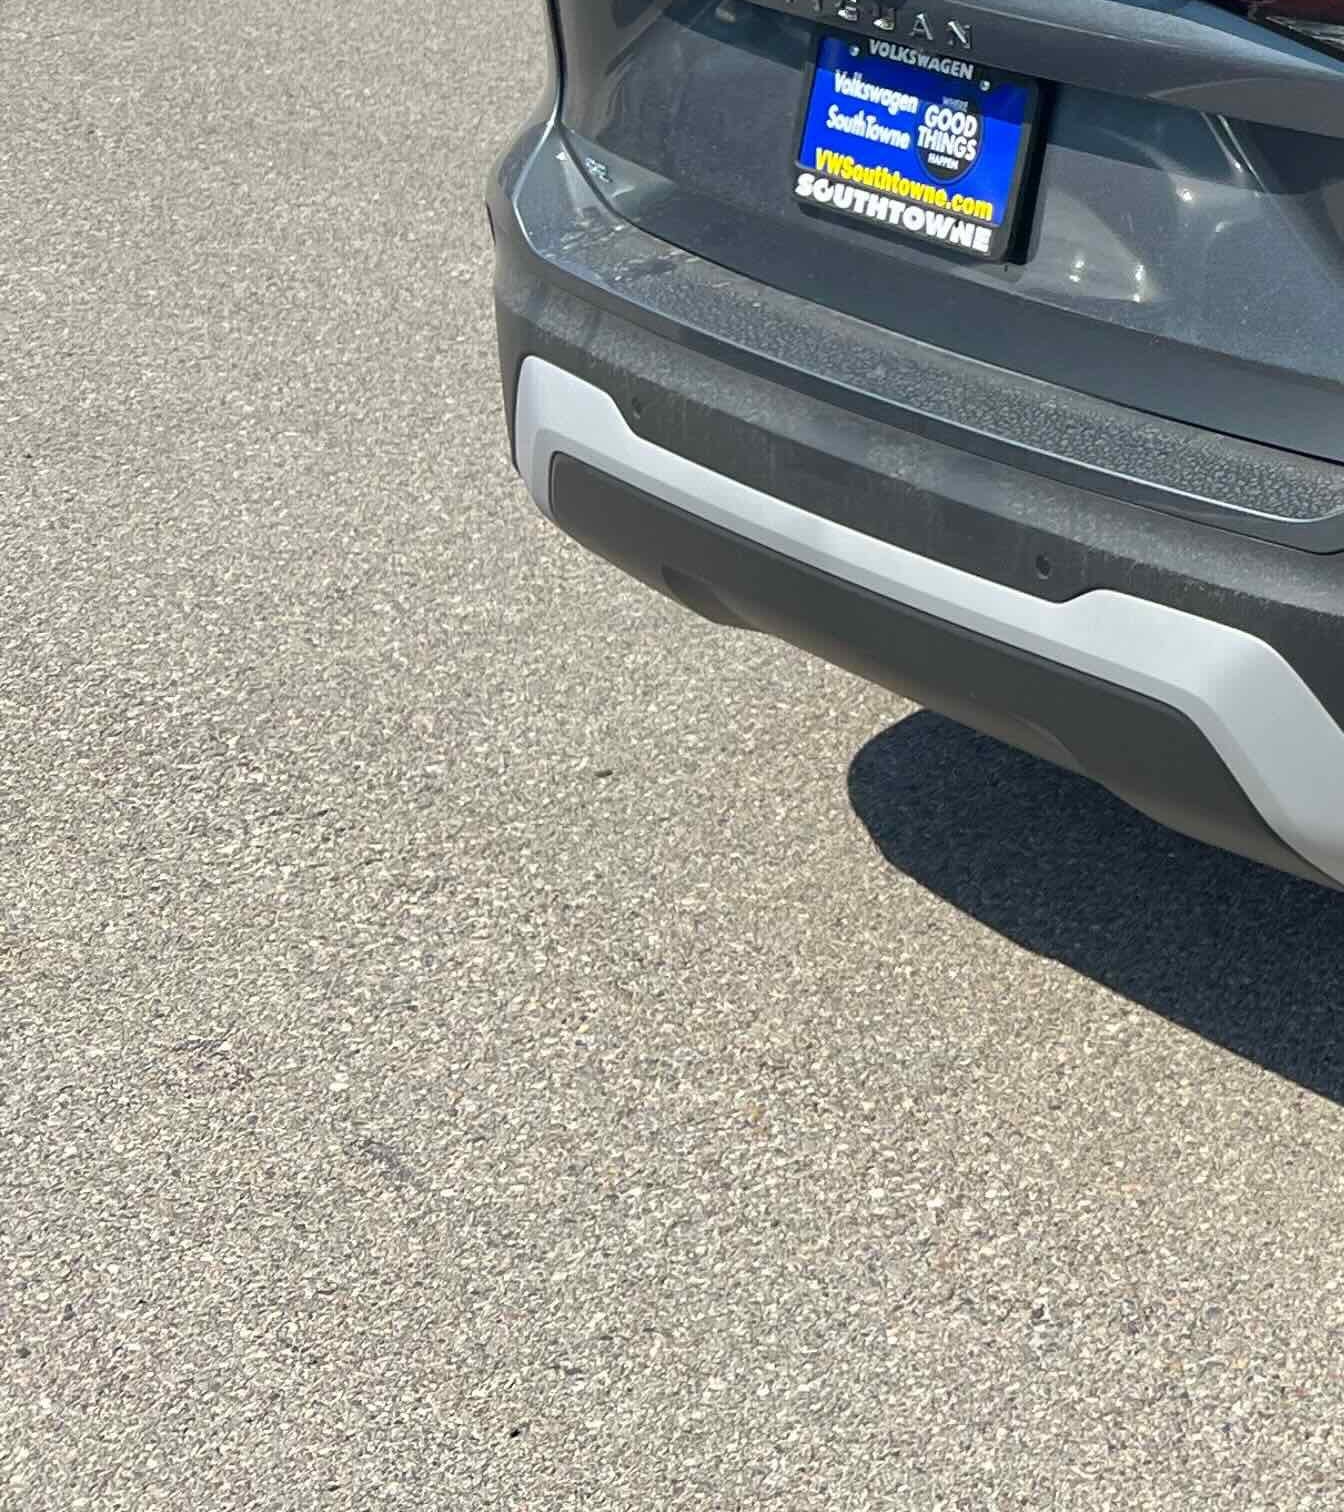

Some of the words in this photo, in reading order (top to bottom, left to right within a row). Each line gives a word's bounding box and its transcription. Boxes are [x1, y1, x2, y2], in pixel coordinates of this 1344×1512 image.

[869, 39, 975, 80] VOLKSWAGEN
[833, 69, 920, 115] Volkswagen
[924, 103, 978, 138] GOOD
[917, 124, 978, 161] THINGS
[814, 146, 993, 221] VWSouthtowne.com
[794, 173, 993, 254] SOUTHTOWNE
